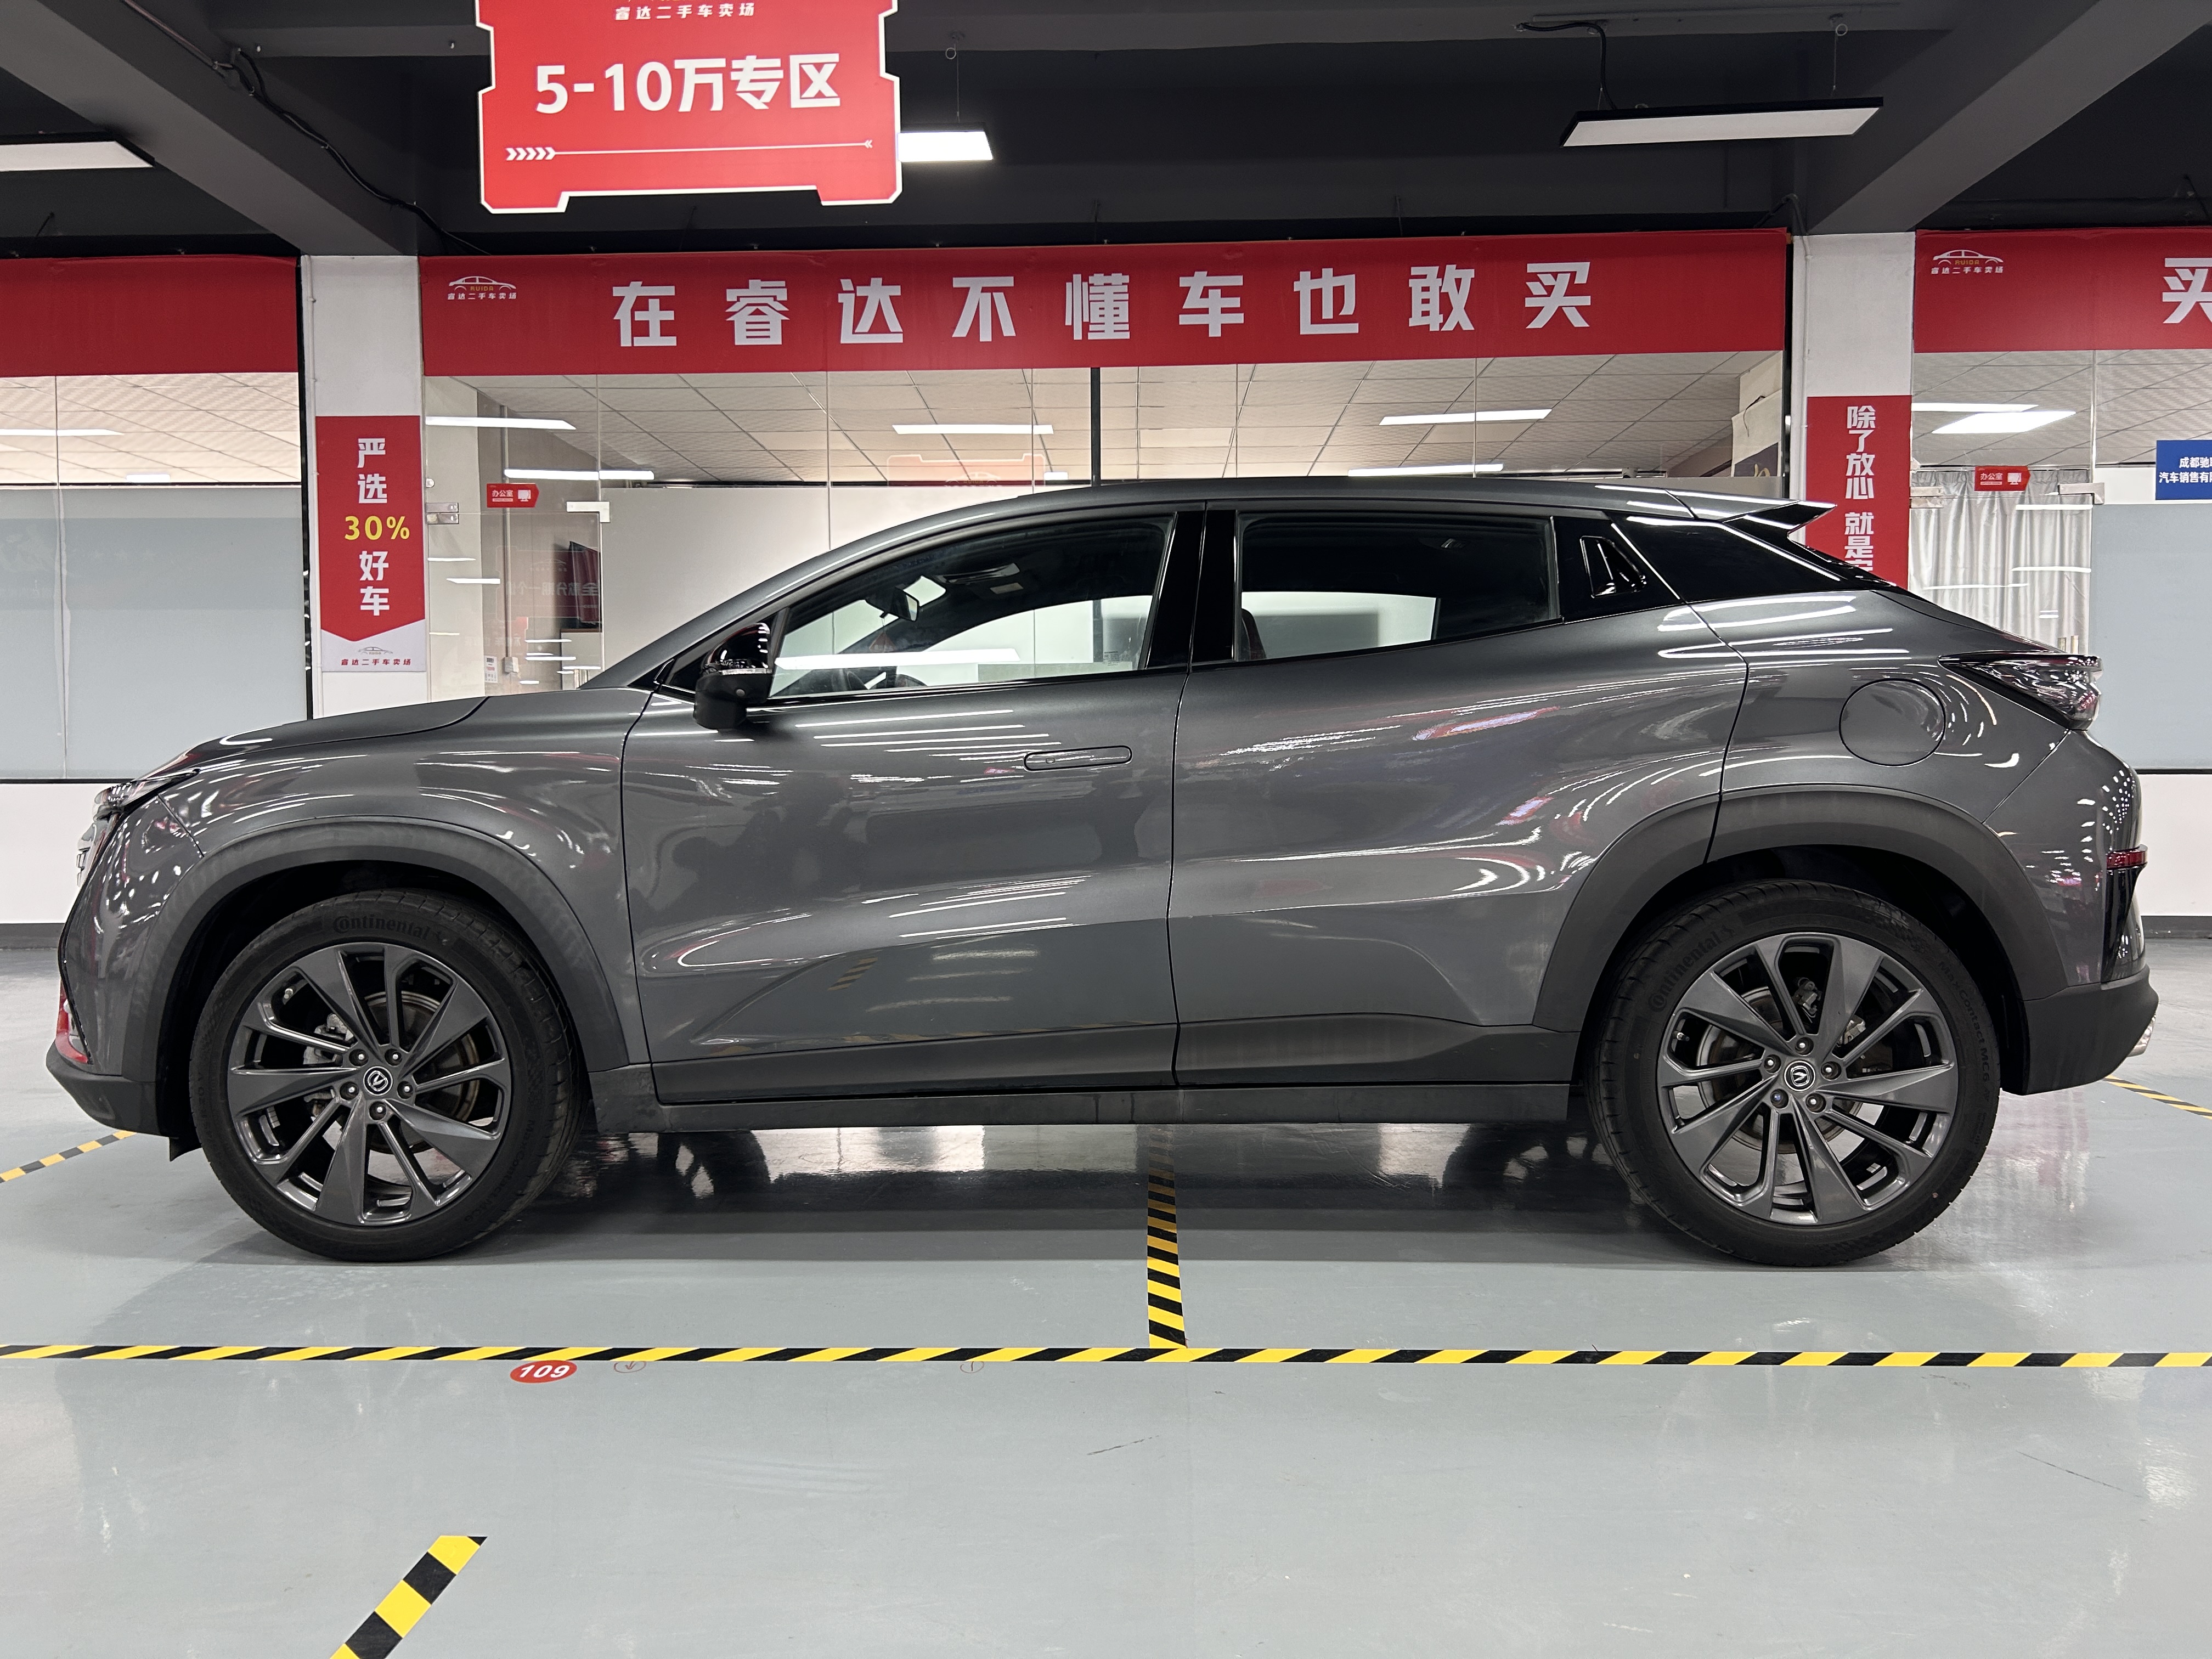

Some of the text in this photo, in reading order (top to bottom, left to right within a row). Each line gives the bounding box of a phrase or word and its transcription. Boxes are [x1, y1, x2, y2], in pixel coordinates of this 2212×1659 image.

[614, 3, 754, 20] 睿达二手车卖场
[536, 53, 840, 114] 5-10万专区
[612, 262, 1592, 347] 在睿达不懂车也敢买
[1846, 405, 1876, 500] 除了放心
[2179, 456, 2212, 468] 成都驰
[345, 515, 410, 540] 30%
[333, 914, 431, 940] Continental
[1647, 930, 1723, 1013] Continental
[520, 1365, 570, 1378] 109
